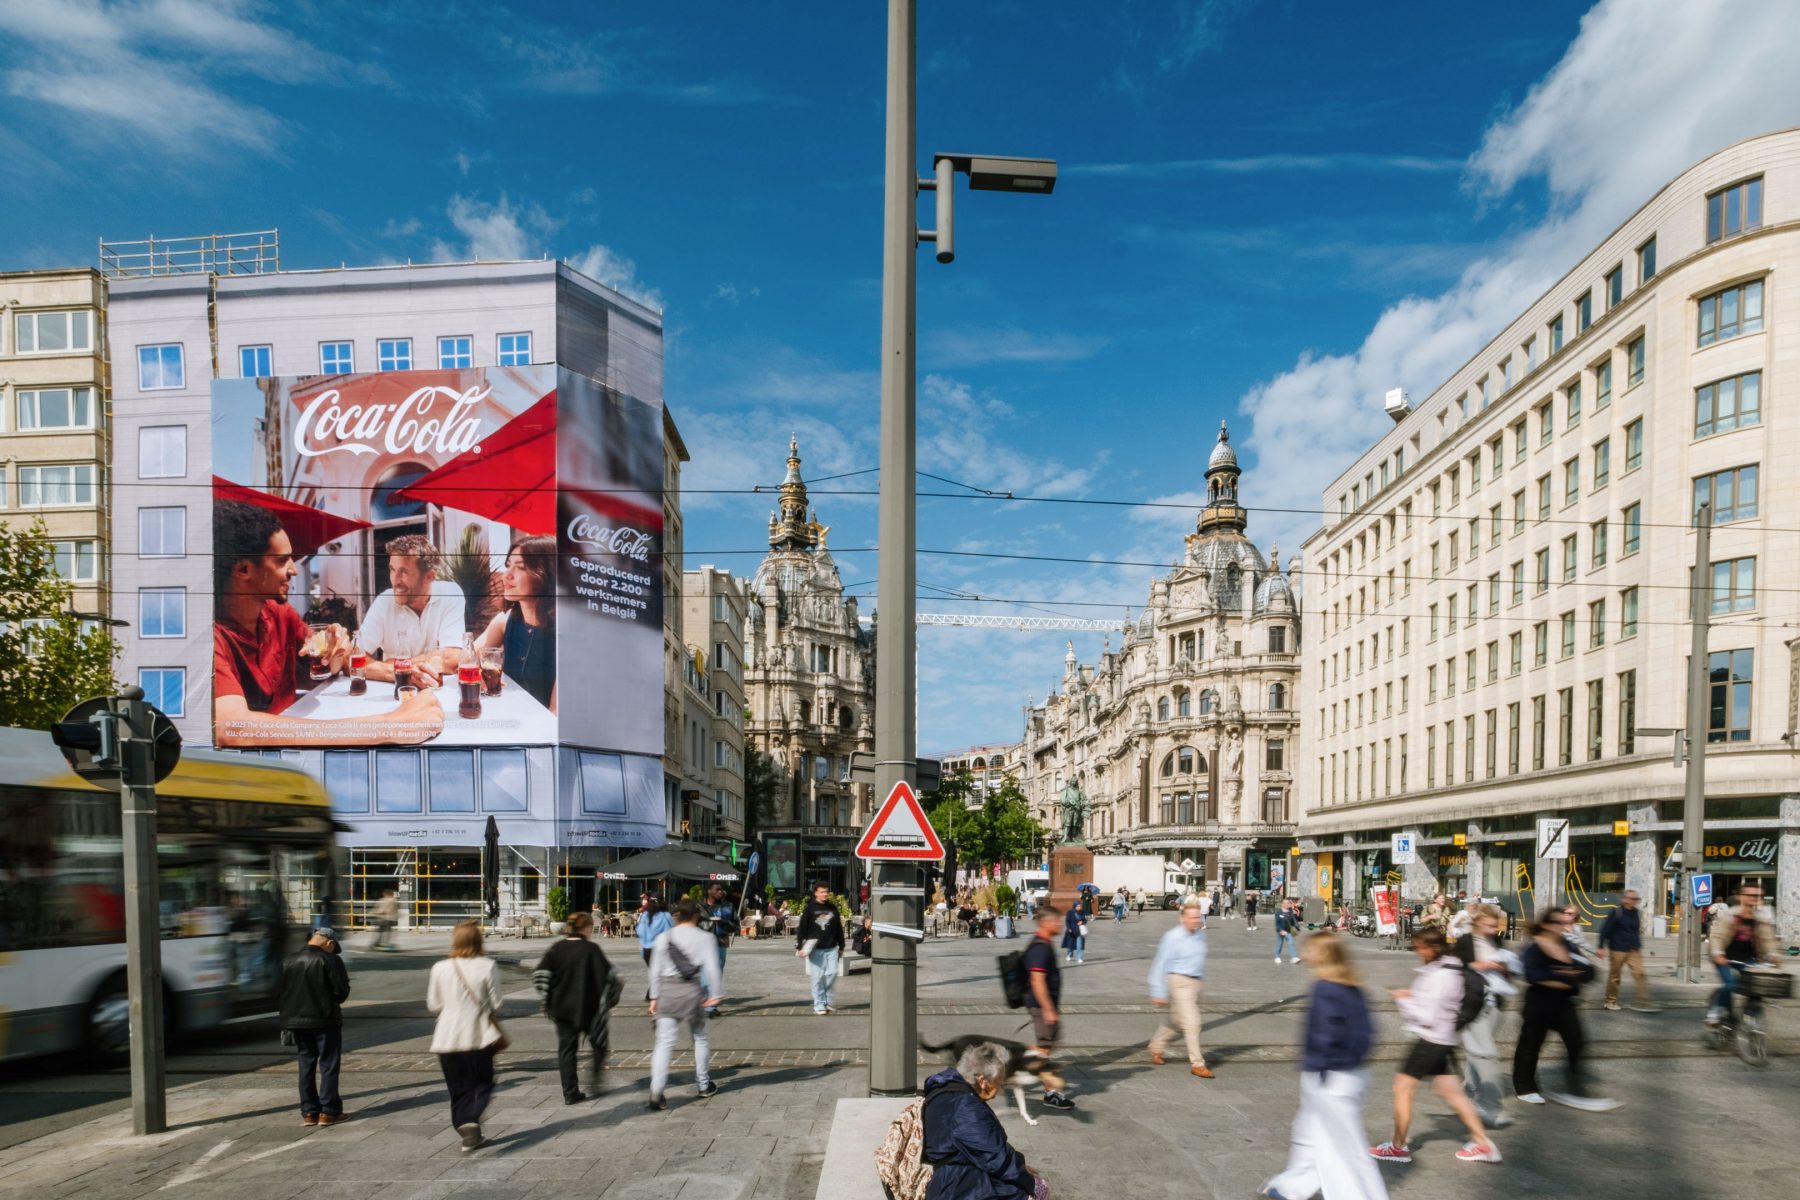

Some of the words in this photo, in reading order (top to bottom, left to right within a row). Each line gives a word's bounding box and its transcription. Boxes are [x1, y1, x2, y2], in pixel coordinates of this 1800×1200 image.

[294, 386, 493, 456] Coca-Cola
[567, 514, 653, 562] Coca-Cola
[570, 557, 651, 586] Geproduceerd
[580, 573, 609, 587] door
[611, 580, 642, 596] 2.200
[576, 586, 648, 609] werknemers
[587, 599, 599, 611] in
[602, 603, 637, 619] België
[1739, 838, 1778, 864] City
